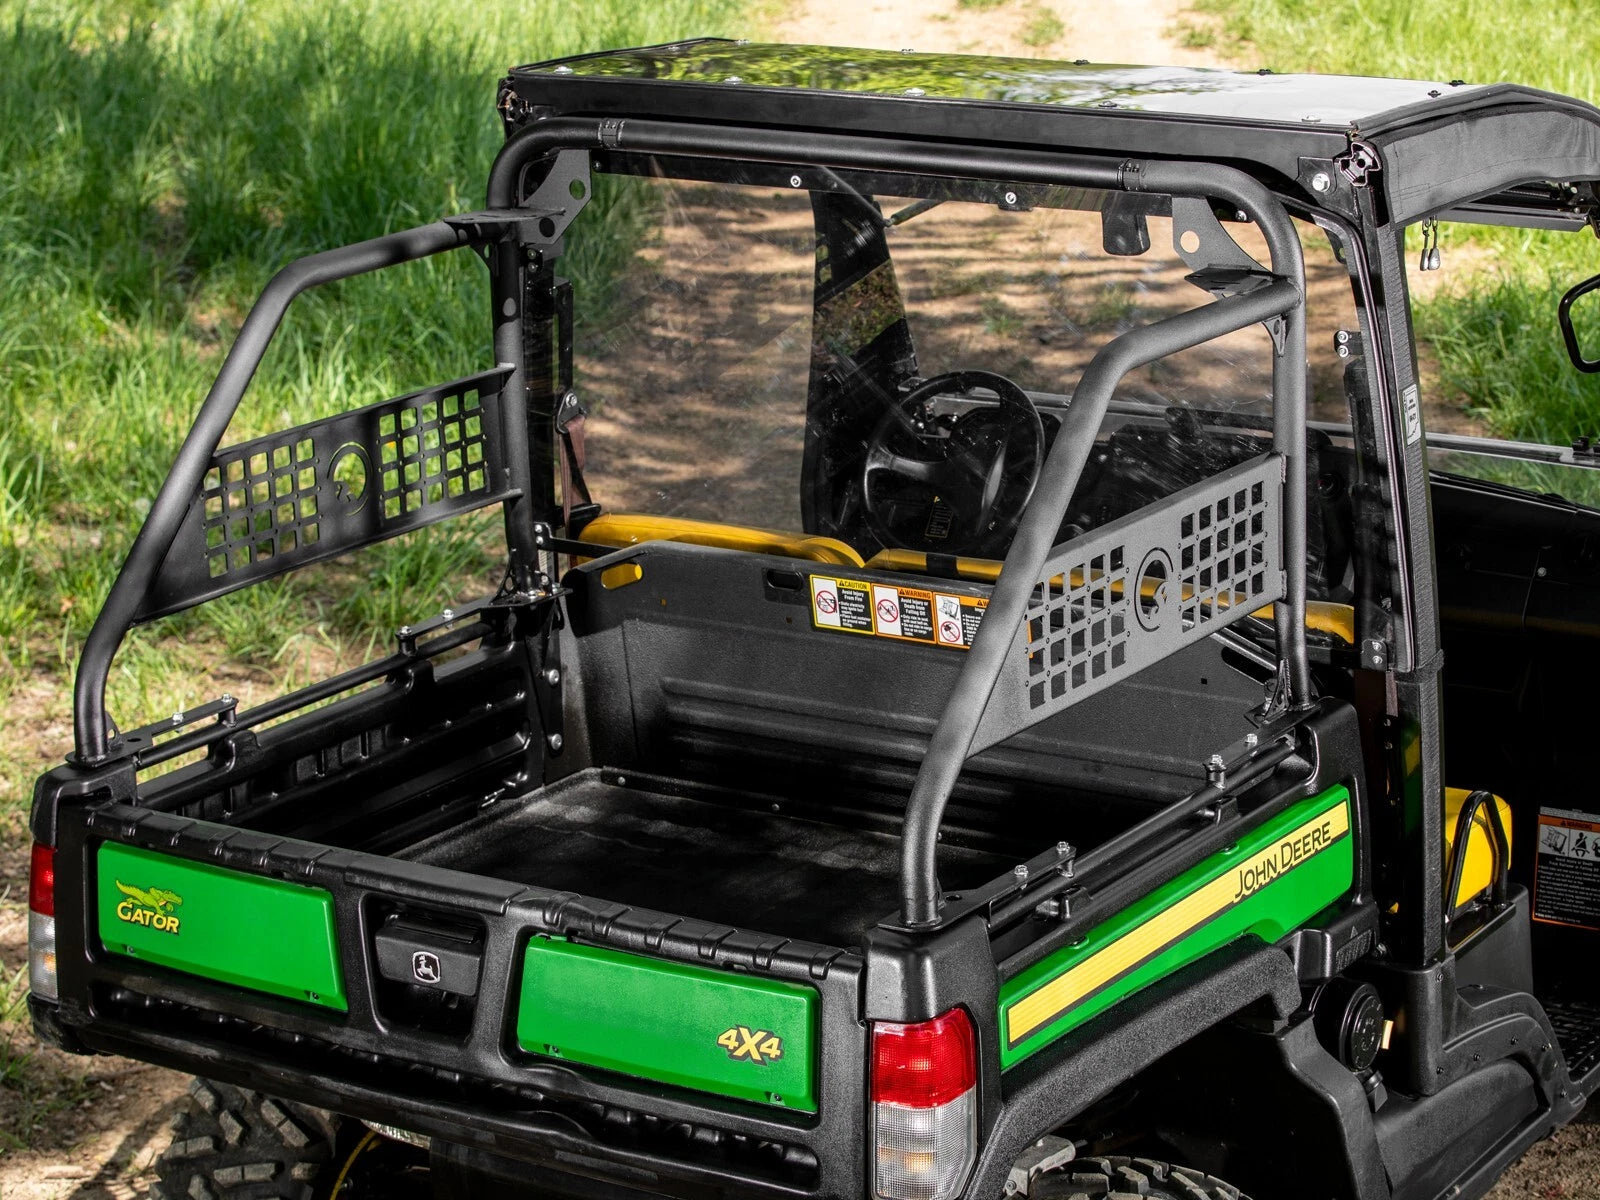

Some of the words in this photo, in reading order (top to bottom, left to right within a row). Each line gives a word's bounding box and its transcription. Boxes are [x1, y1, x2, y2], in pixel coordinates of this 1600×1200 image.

[844, 581, 867, 589] CAUTION
[905, 589, 930, 598] WARNING
[1235, 853, 1277, 899] JOHN
[1280, 820, 1331, 869] DEERE
[117, 901, 180, 934] GATOR
